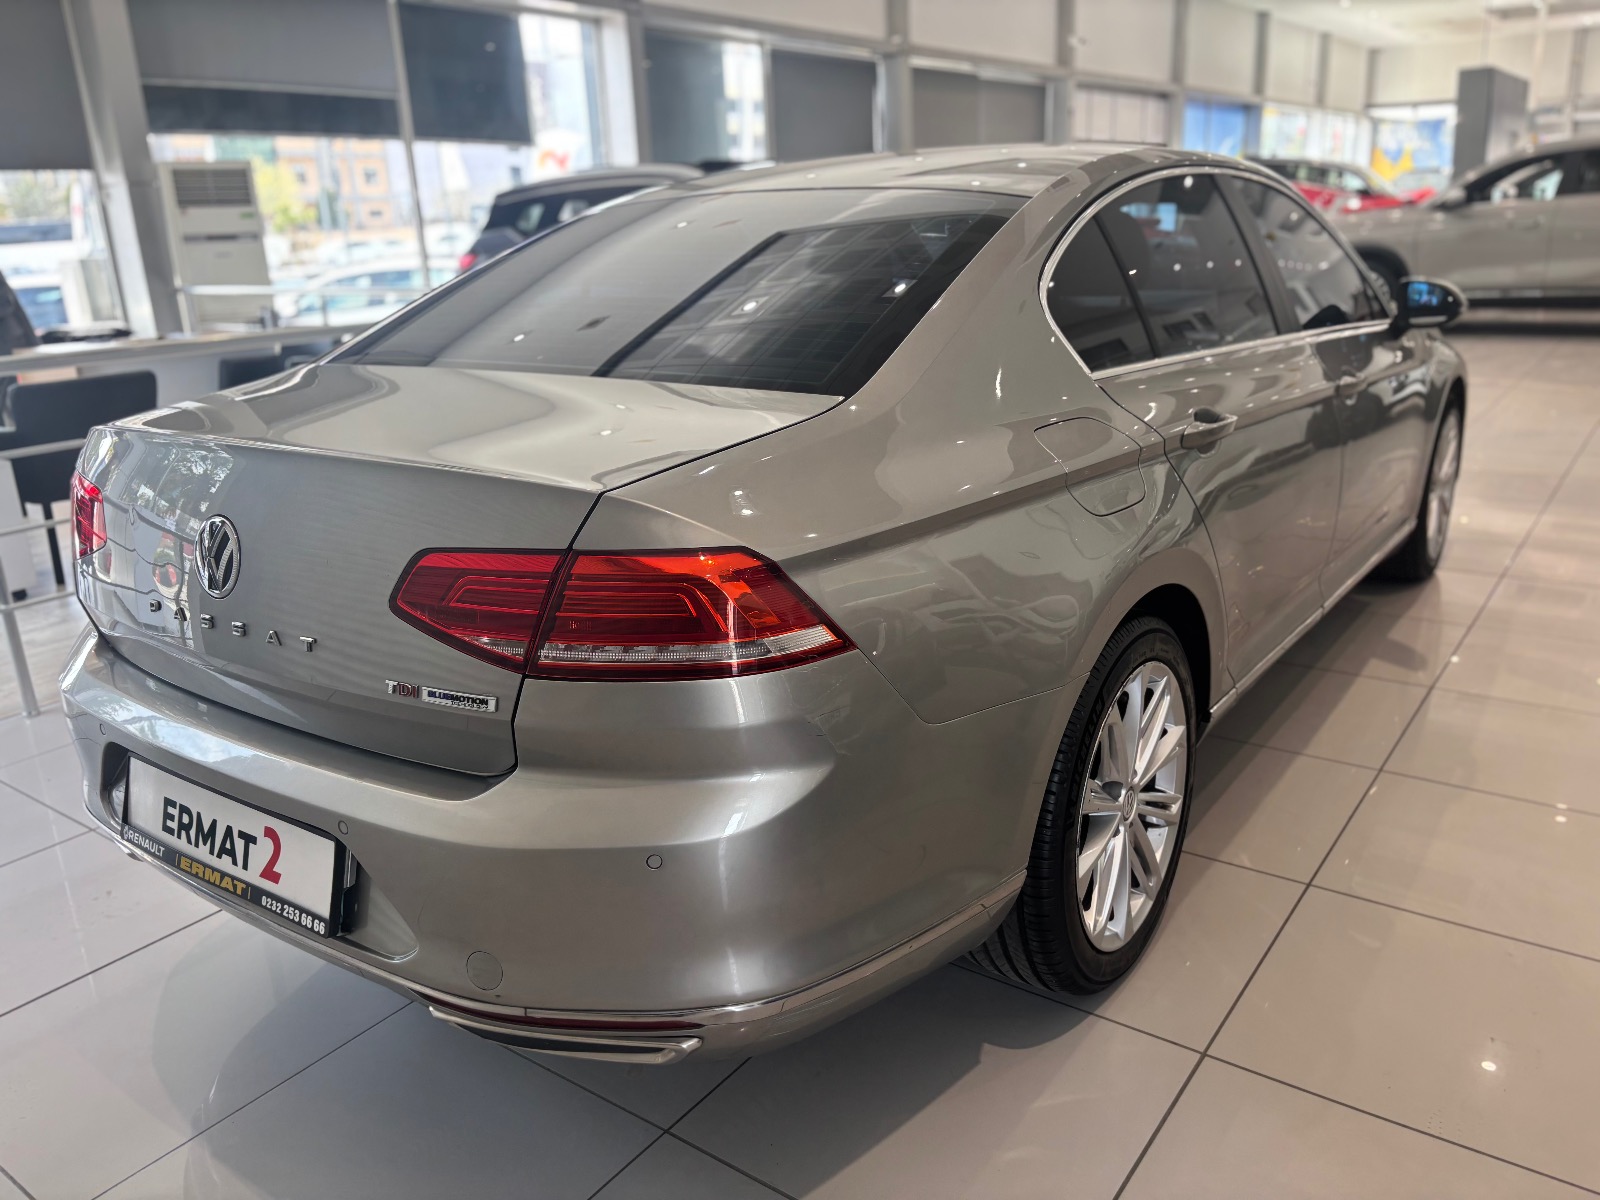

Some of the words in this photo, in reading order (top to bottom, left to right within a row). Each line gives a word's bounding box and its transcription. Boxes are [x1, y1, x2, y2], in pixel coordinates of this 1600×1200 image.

[149, 599, 317, 652] PASSAT
[385, 679, 418, 699] TDI
[427, 690, 489, 706] BLUEMOTION
[128, 830, 165, 857] RENAULT
[162, 796, 257, 871] ERMAT
[259, 826, 282, 885] 2
[180, 856, 246, 895] ERMAT
[261, 895, 281, 914] 0232
[282, 904, 300, 922] 253
[300, 912, 313, 928] 66
[313, 919, 326, 935] 66
